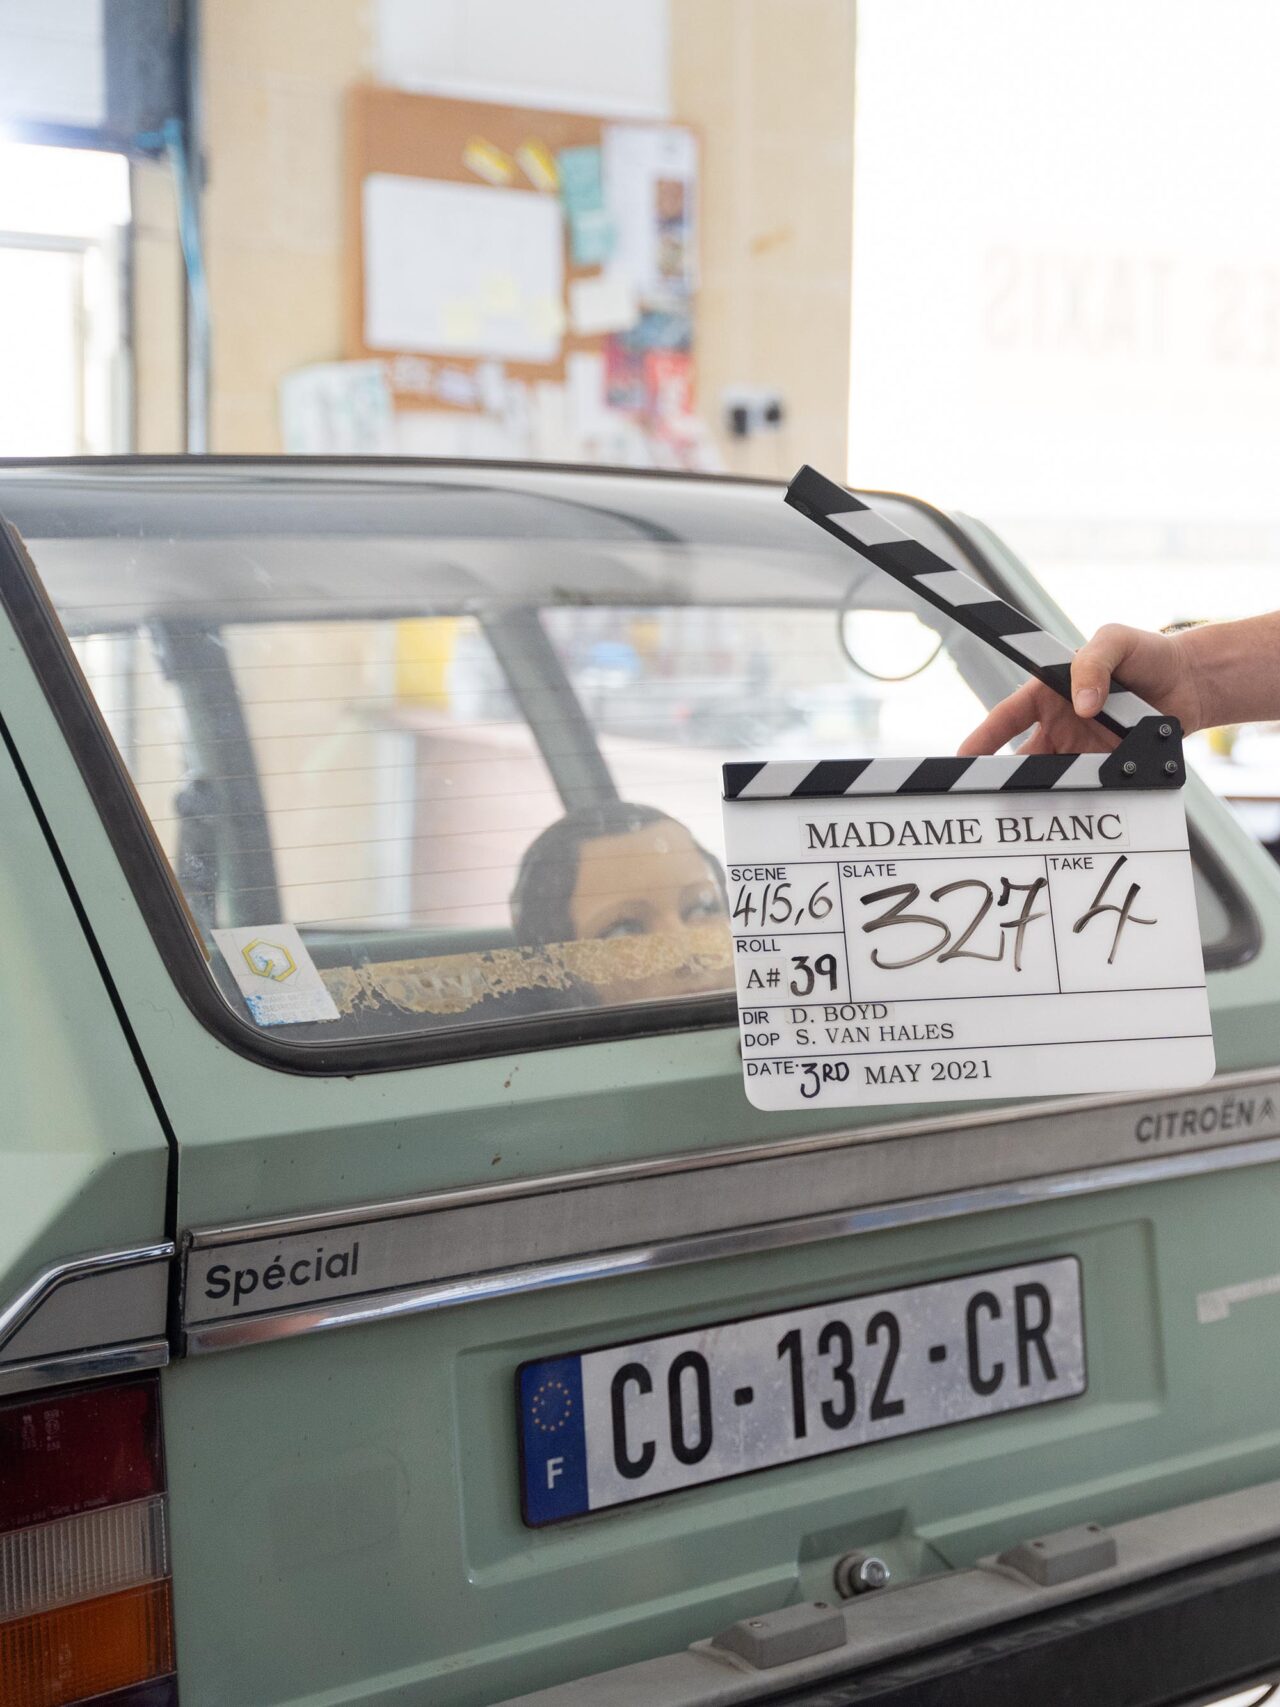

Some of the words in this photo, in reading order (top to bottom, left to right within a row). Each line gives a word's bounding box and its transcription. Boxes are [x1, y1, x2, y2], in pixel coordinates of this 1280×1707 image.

[806, 817, 982, 849] MADAME
[997, 813, 1123, 844] BLANC
[731, 867, 787, 881] SCENE
[843, 864, 897, 878] SLATE
[1050, 857, 1094, 871] TAKE
[1073, 855, 1157, 964] 4
[860, 876, 1047, 972] 327
[736, 939, 781, 953] ROLL
[746, 968, 780, 989] A#
[790, 954, 837, 997] 39
[742, 1011, 770, 1025] DIR
[791, 1008, 815, 1024] D.
[824, 1003, 888, 1024] BOYD
[744, 1032, 780, 1047] DOP
[796, 1029, 816, 1045] S.
[825, 1027, 870, 1044] VAN
[879, 1023, 954, 1042] HALES
[864, 1063, 922, 1085] MAY
[931, 1060, 992, 1081] 2021
[1135, 1095, 1255, 1144] CITROËN
[205, 1242, 359, 1306] Spécial
[546, 1457, 563, 1489] F
